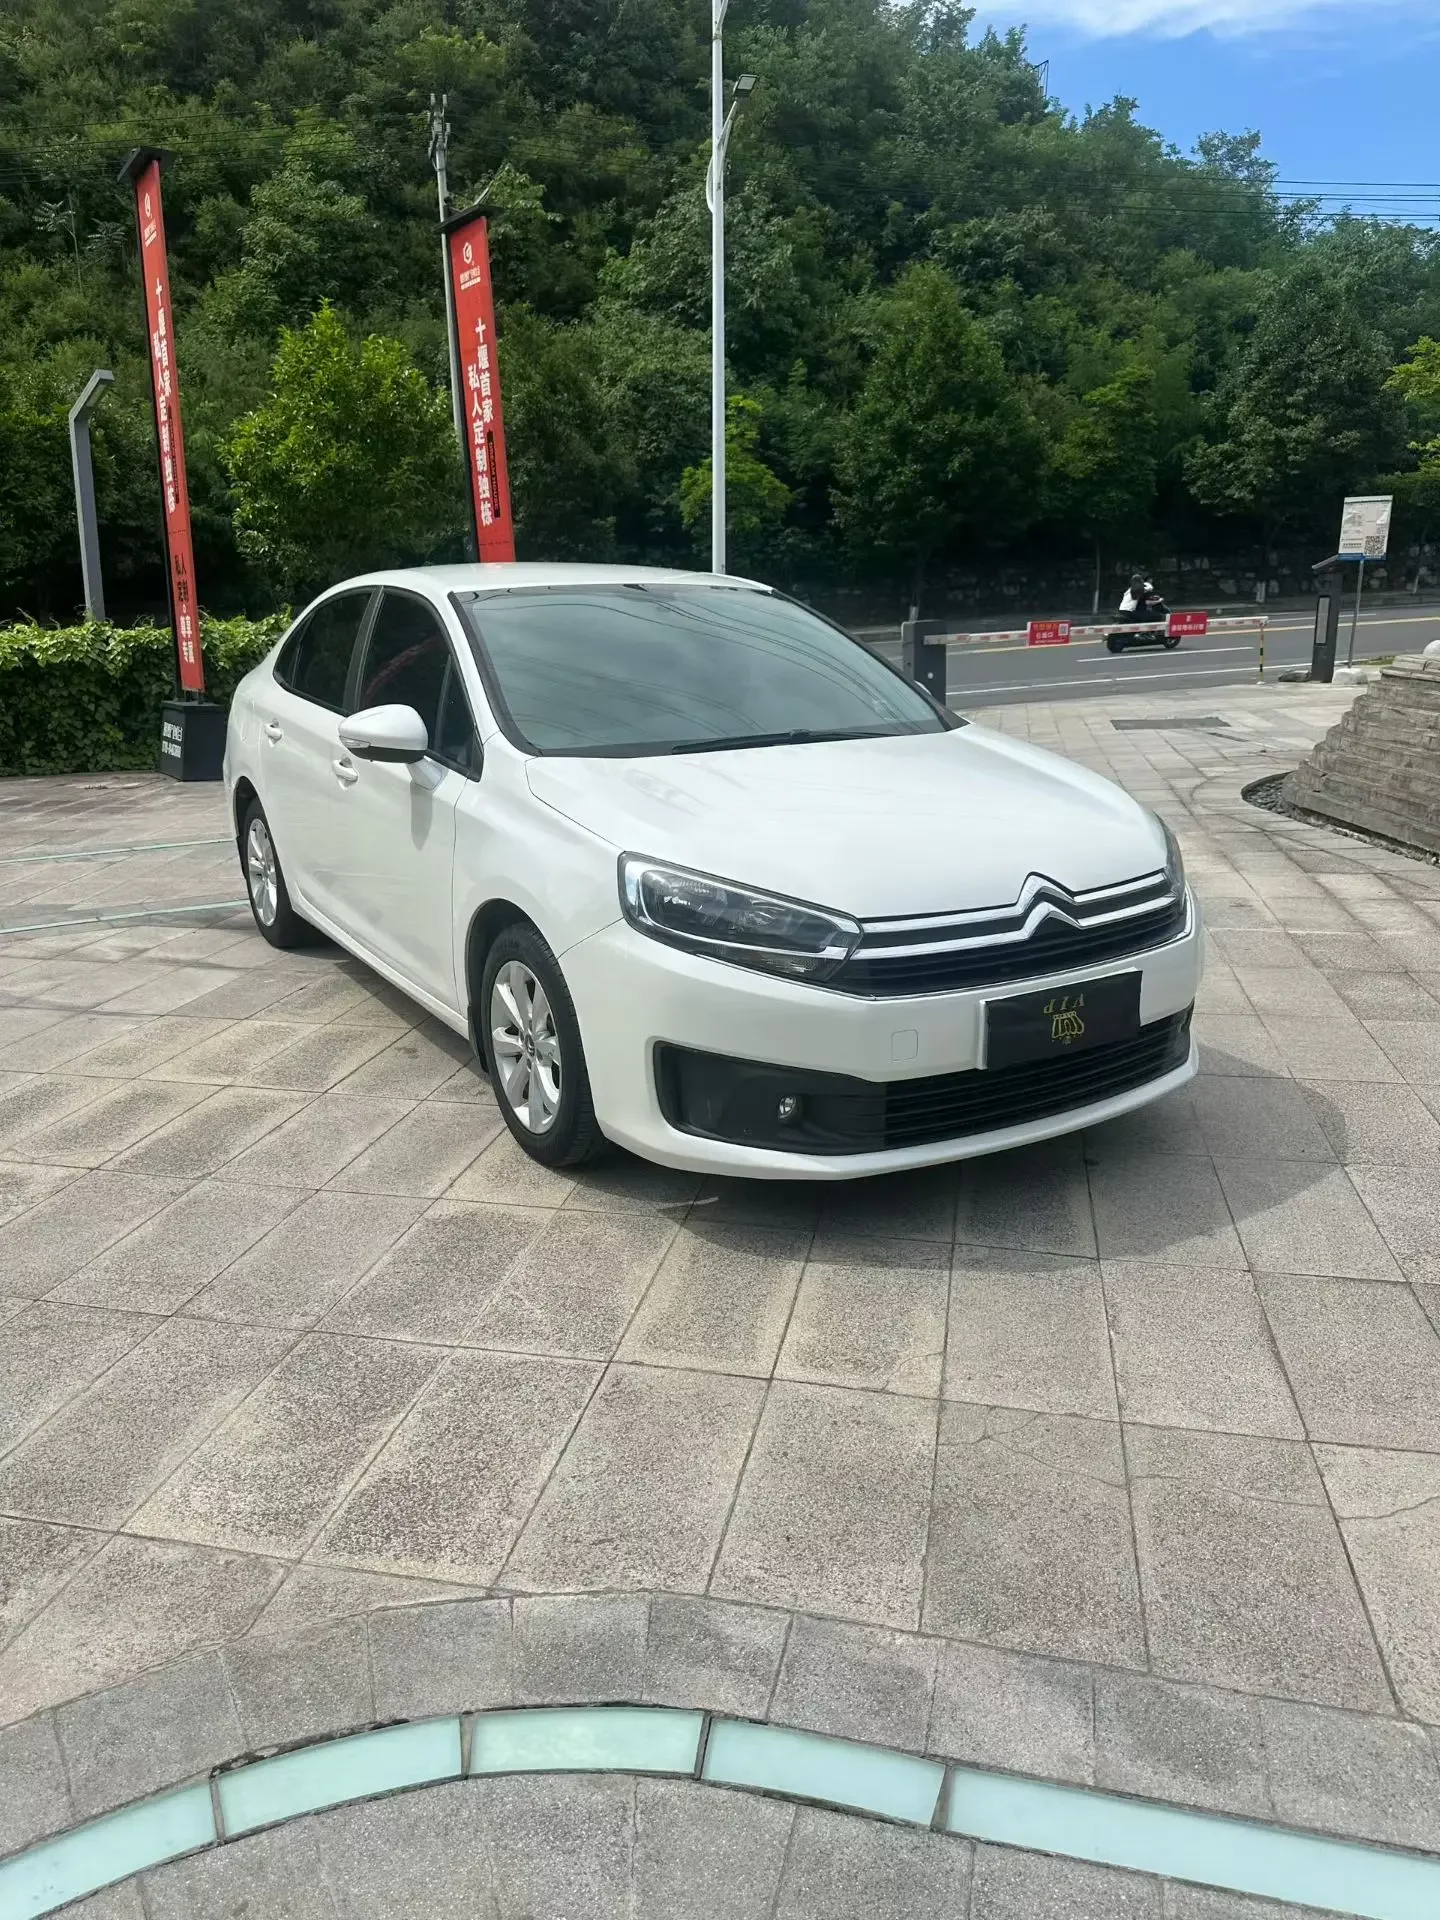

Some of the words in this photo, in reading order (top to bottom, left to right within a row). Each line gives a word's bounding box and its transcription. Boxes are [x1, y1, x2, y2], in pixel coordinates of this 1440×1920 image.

[475, 317, 494, 425] 十堰首家
[468, 364, 492, 527] 私人定制独栋
[1043, 992, 1085, 1015] VIP
